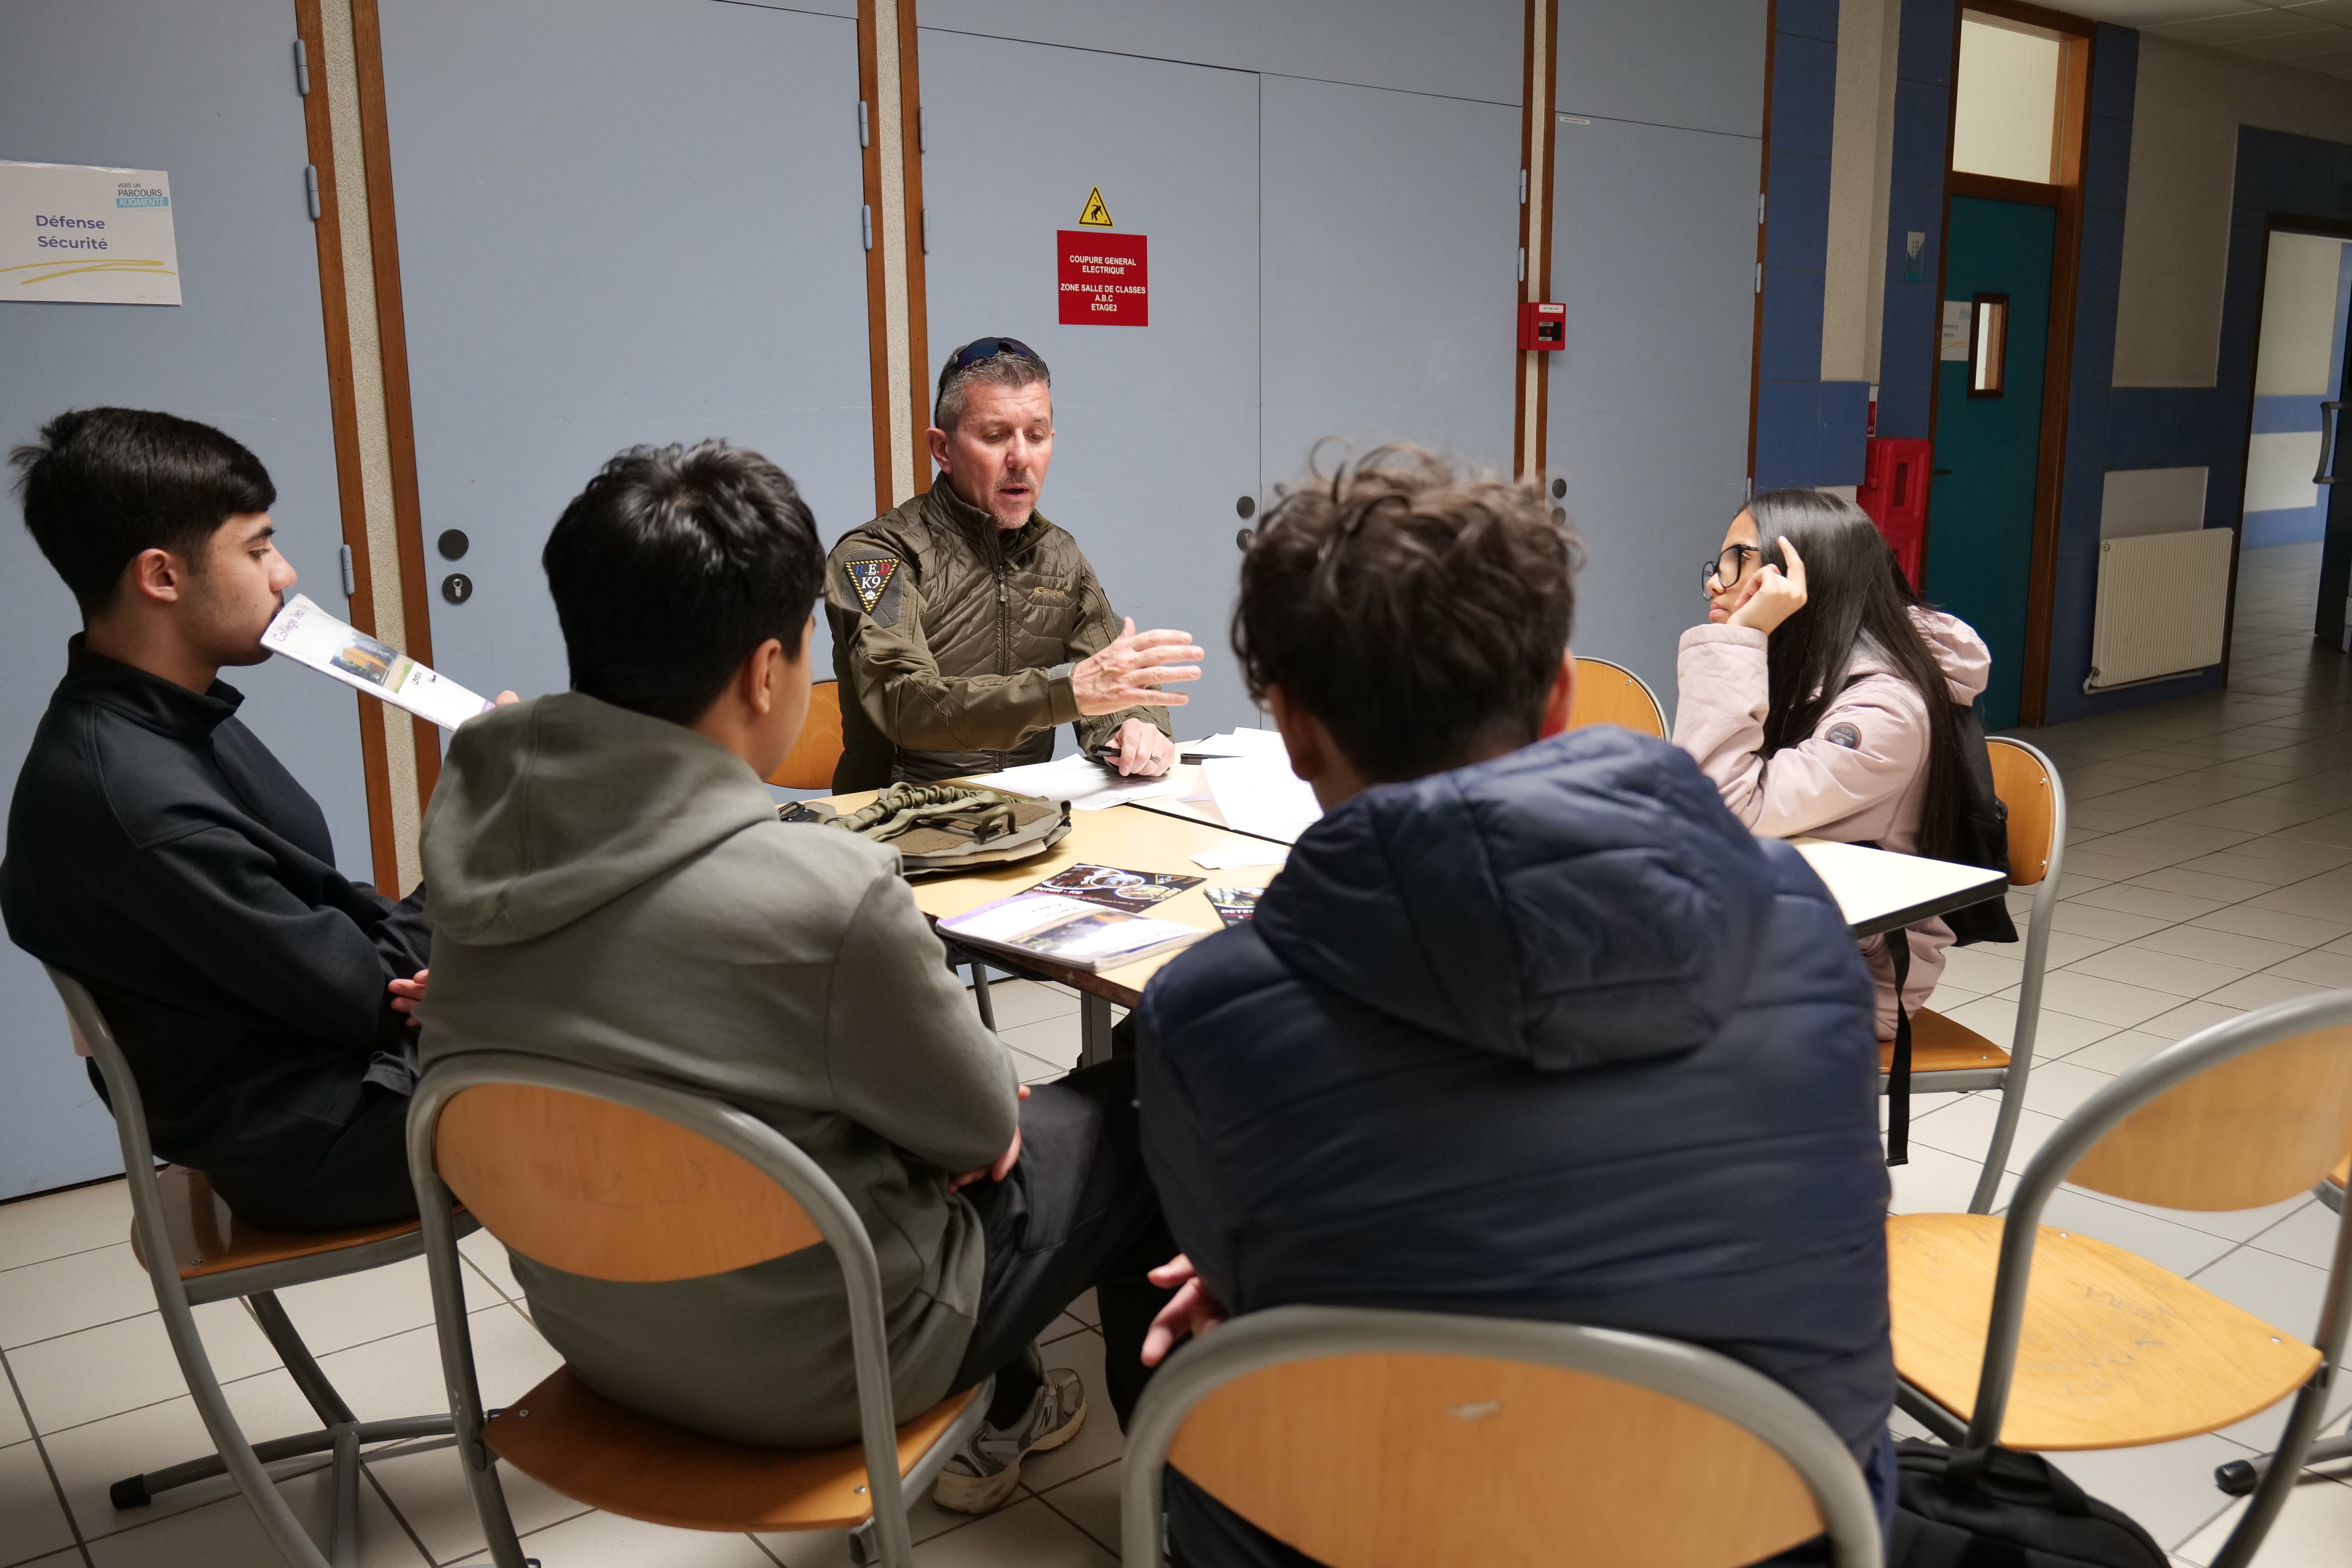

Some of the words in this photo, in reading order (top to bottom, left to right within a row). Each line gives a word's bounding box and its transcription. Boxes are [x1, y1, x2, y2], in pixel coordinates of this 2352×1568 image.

[119, 197, 165, 207] AUGMENTÉ
[36, 215, 105, 229] Défense
[38, 236, 108, 250] Sécurité
[1069, 255, 1103, 264] COUPURE
[1104, 257, 1136, 266] GENERAL
[1082, 265, 1125, 274] ELECTRIQUE
[1060, 283, 1080, 292] ZONE
[1081, 284, 1103, 292] SALLE
[1115, 285, 1146, 294] CLASSES
[1091, 303, 1118, 312] ETAGE2
[861, 576, 881, 589] K9
[1034, 586, 1065, 596] CARINTHIA
[273, 619, 299, 641] Collège
